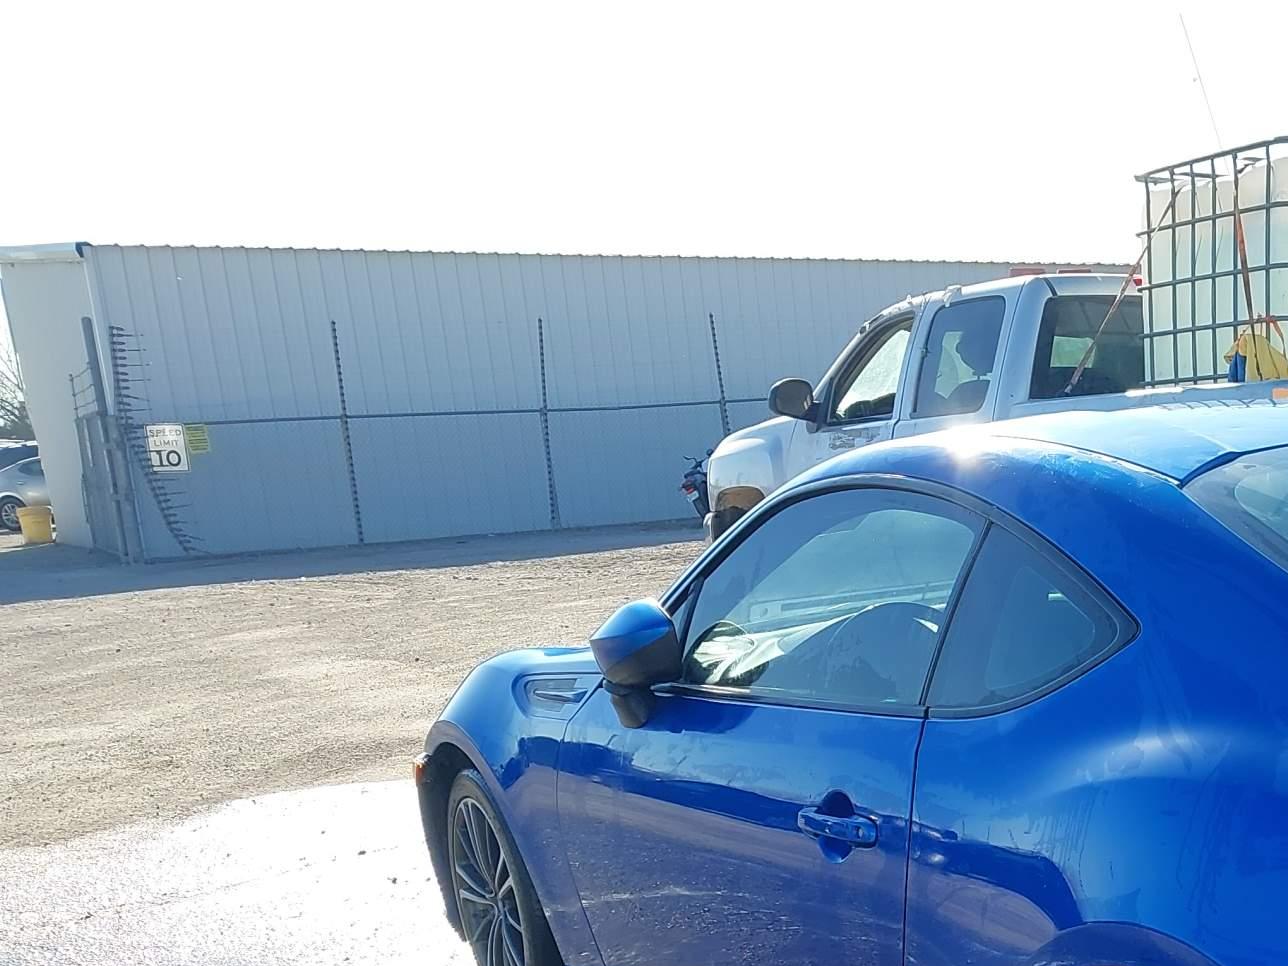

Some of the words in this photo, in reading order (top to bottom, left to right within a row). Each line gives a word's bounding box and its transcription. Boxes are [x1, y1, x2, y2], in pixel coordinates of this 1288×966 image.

[149, 429, 182, 437] SPEED
[153, 439, 180, 447] LIMIT
[155, 449, 182, 467] 10
